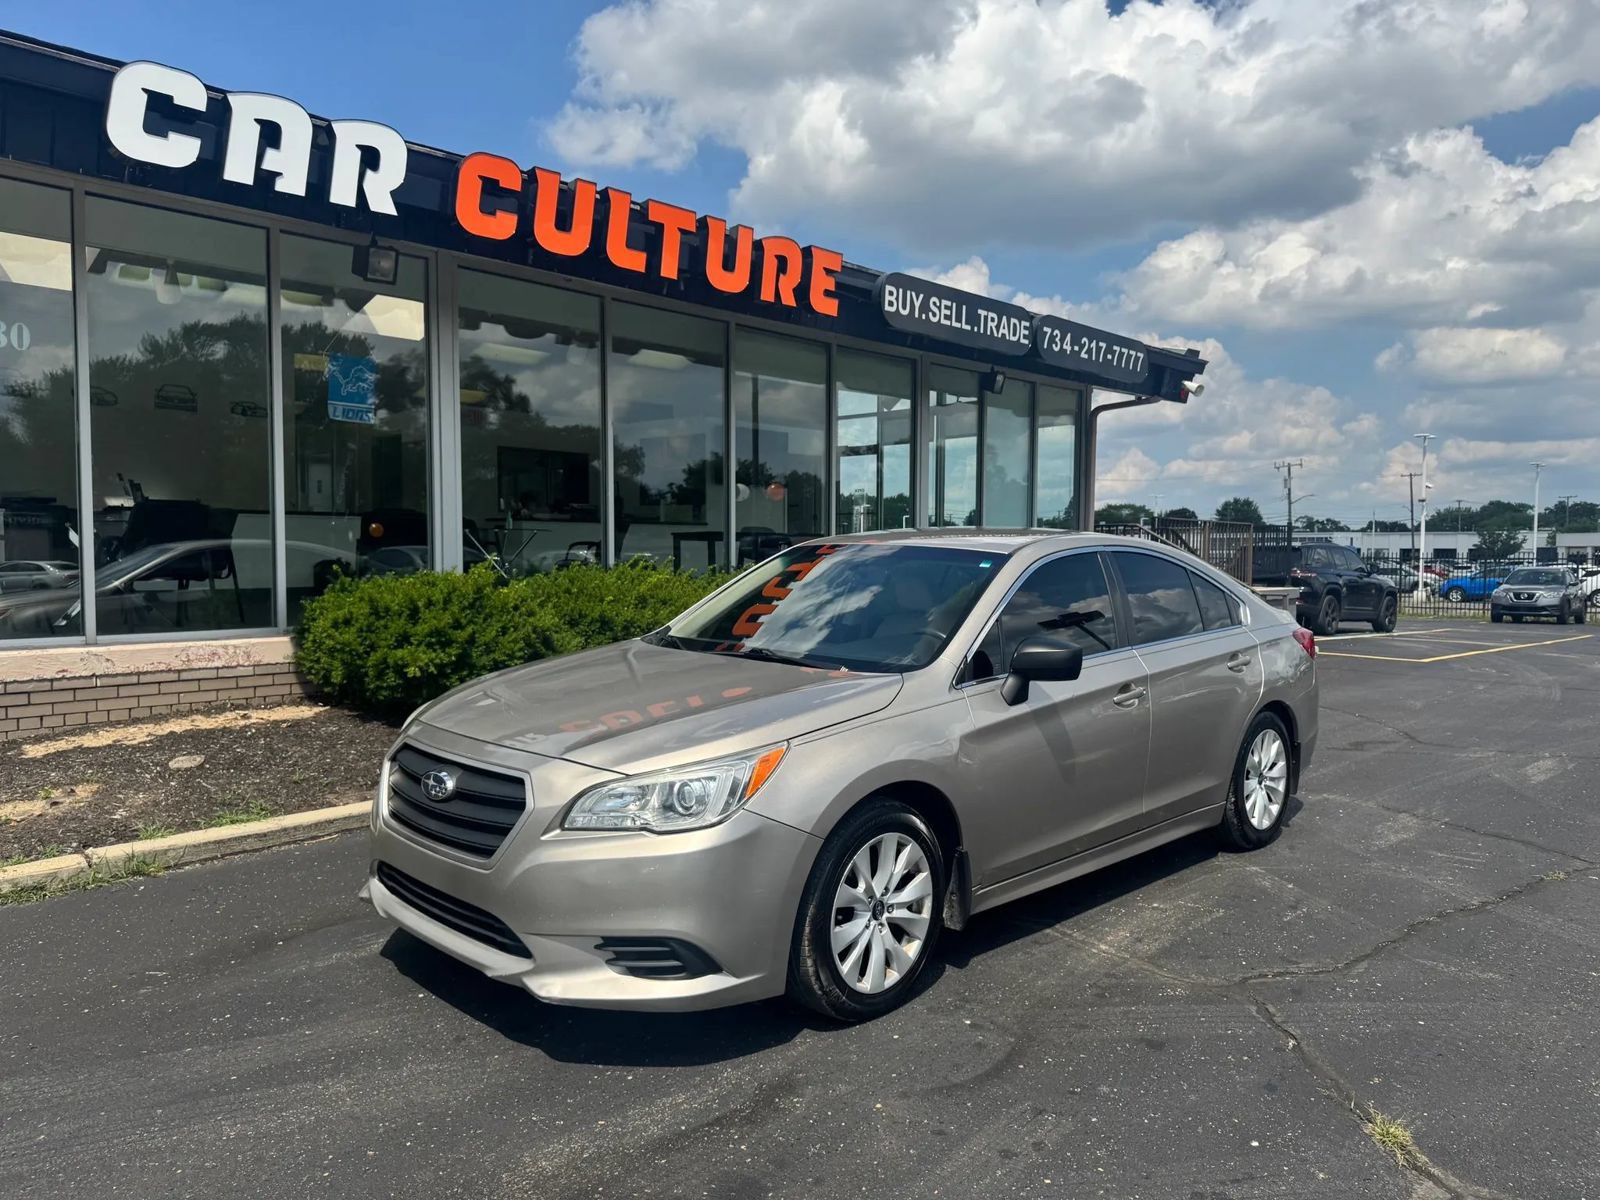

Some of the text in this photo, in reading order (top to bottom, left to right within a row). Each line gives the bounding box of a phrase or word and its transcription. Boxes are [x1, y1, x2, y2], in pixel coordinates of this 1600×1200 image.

[107, 61, 843, 317] CAR CULTURE
[1043, 326, 1144, 372] 734-217-7777
